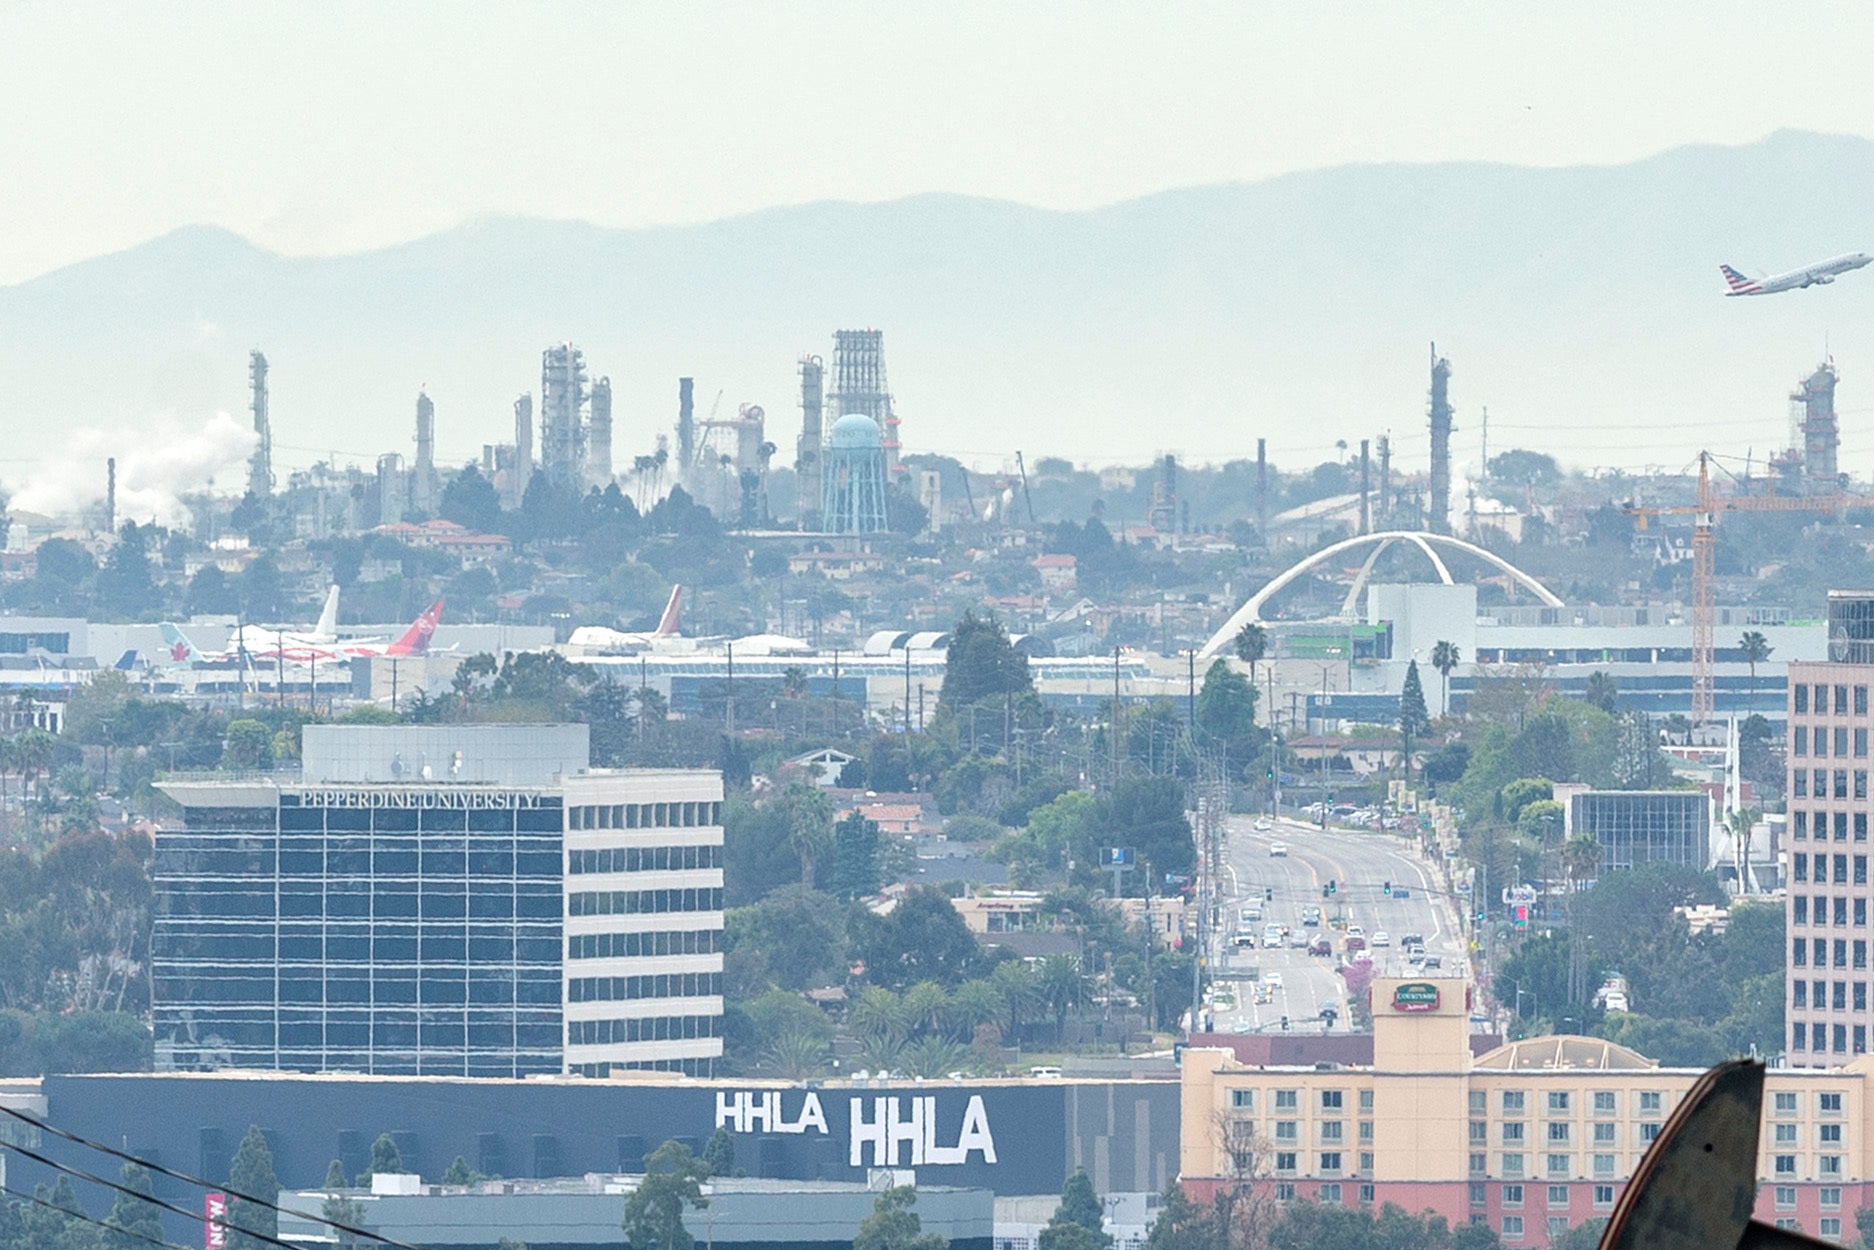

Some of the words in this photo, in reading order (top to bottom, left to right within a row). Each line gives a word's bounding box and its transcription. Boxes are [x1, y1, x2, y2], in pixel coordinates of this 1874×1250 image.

[302, 791, 418, 809] PEPPERDINE
[423, 791, 537, 809] UNIVERSITY
[715, 1091, 829, 1134] HHLA
[850, 1095, 997, 1166] HHLA
